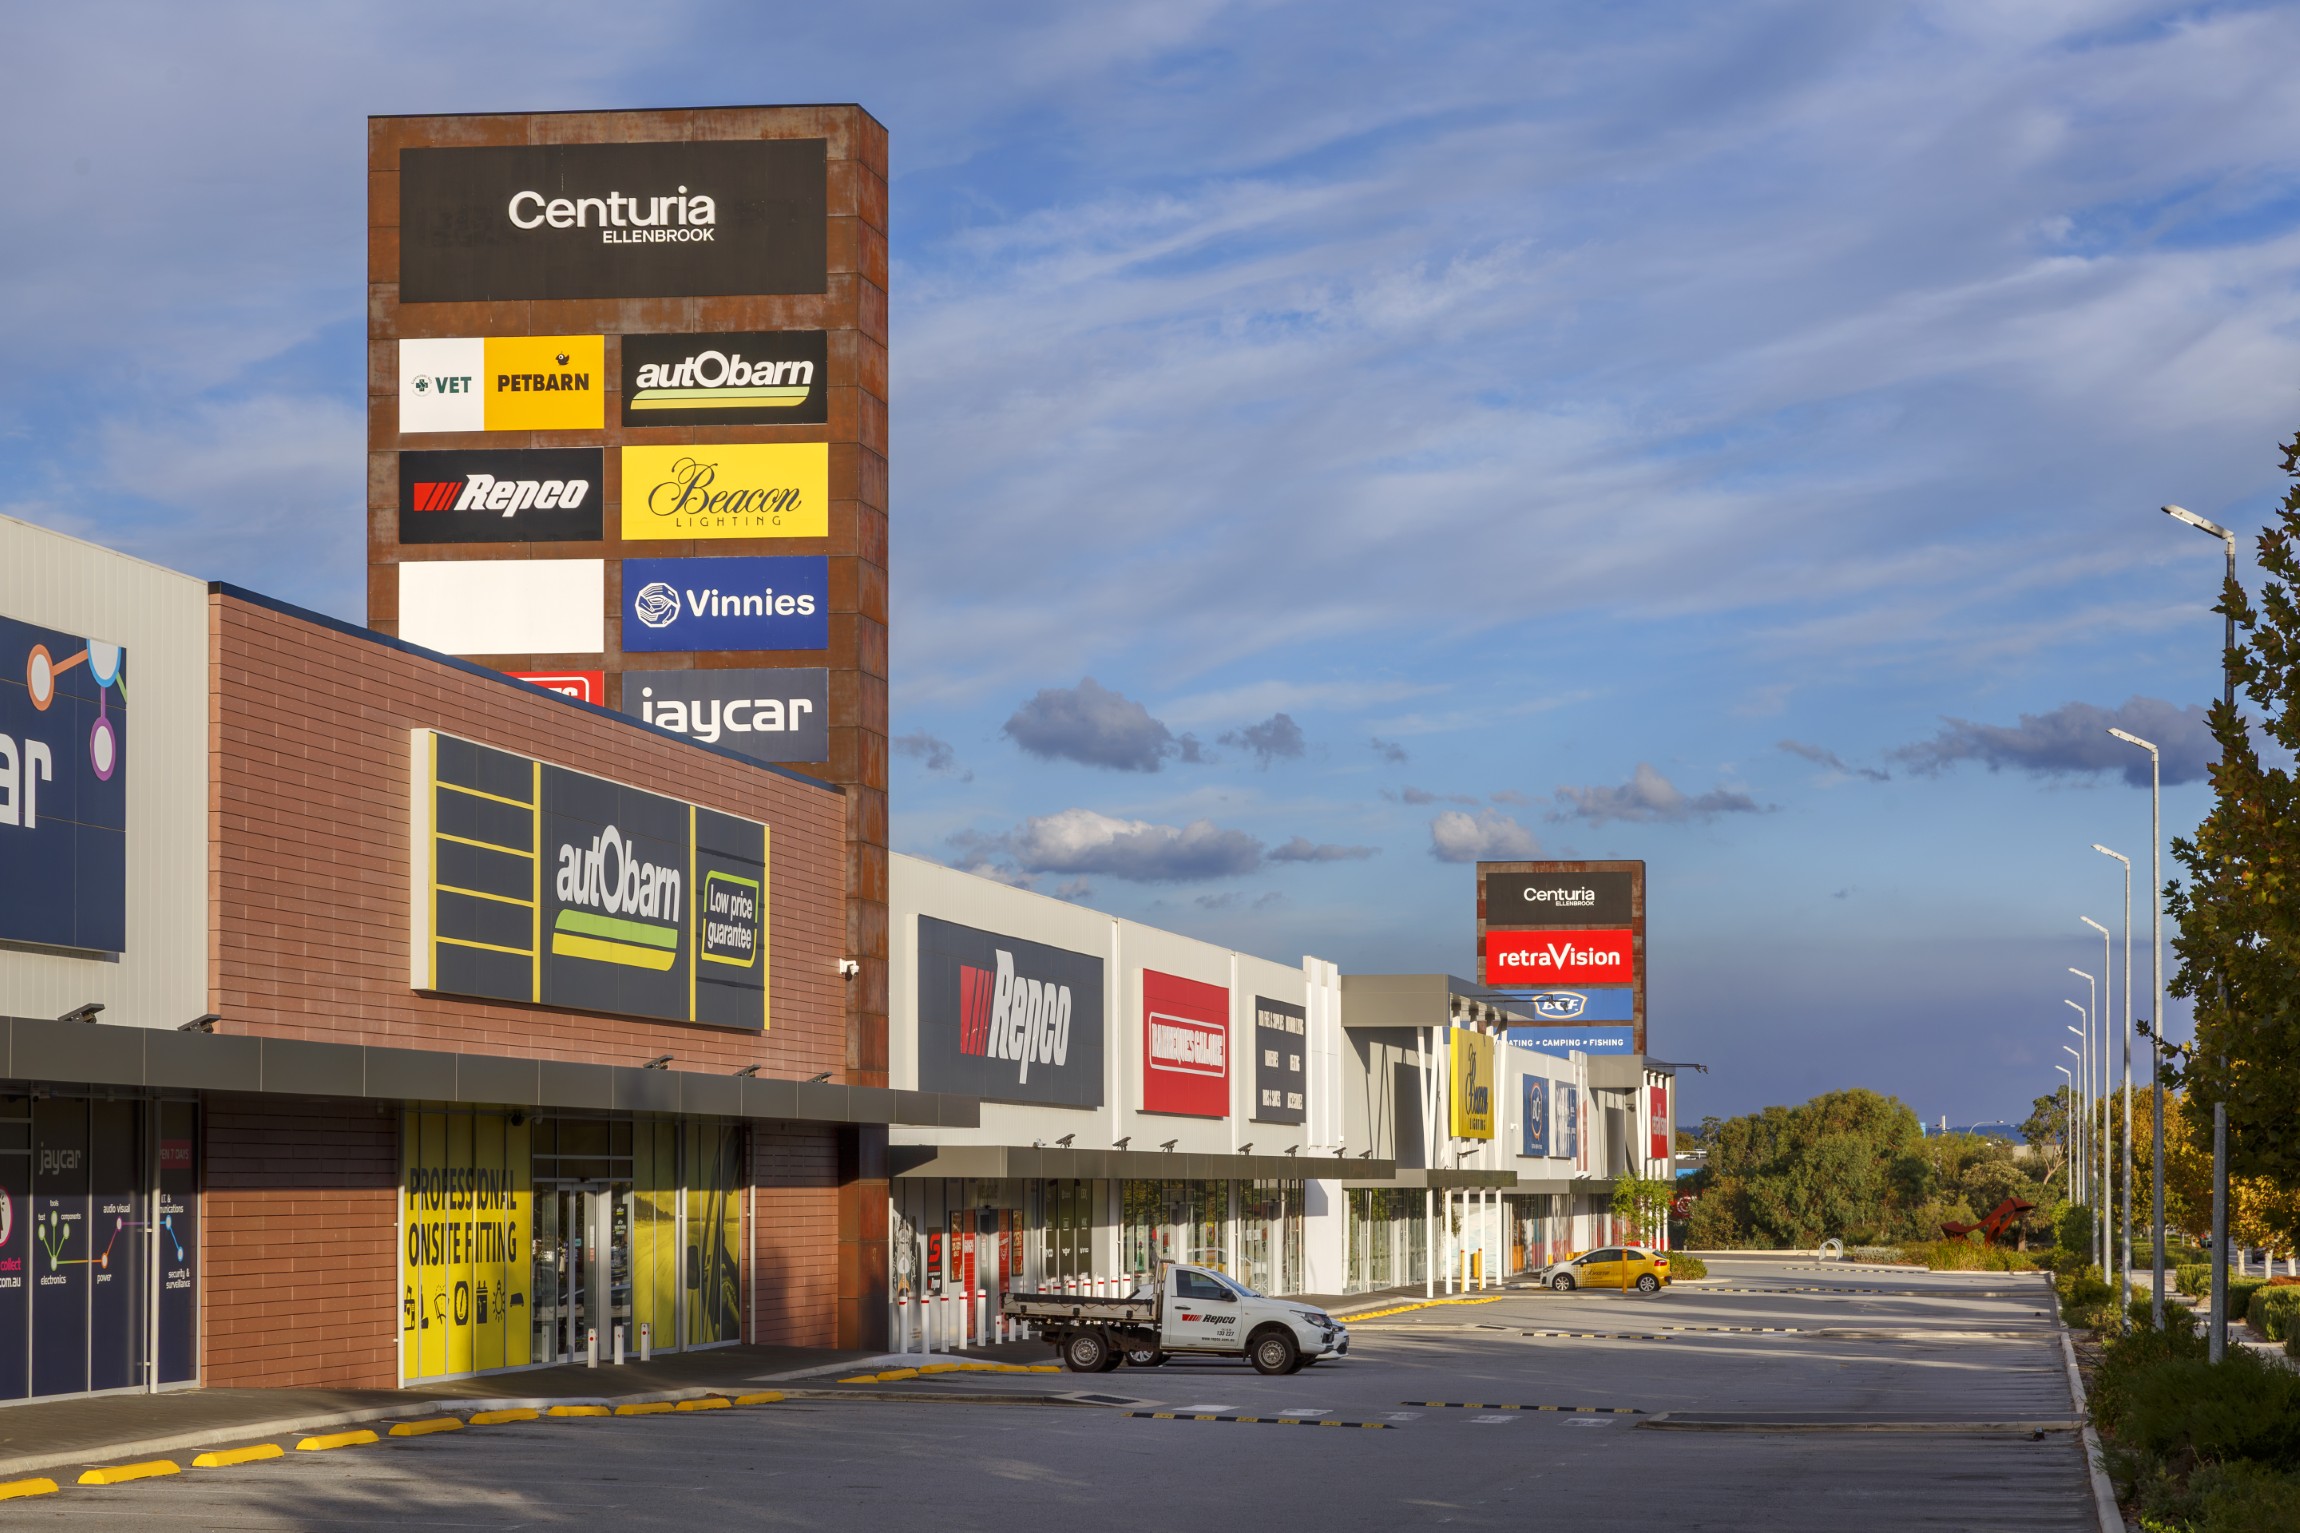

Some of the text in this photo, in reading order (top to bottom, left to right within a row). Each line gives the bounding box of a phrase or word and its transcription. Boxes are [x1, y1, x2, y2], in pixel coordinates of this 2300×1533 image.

[508, 186, 716, 230] Centuria
[603, 228, 715, 244] ELLENBROOK
[497, 373, 589, 393] PETBARN
[636, 350, 814, 389] autObarn
[435, 376, 472, 394] VET
[454, 474, 589, 518] Repco
[648, 457, 802, 515] Beacon
[676, 515, 781, 527] LIGHTING
[686, 587, 816, 617] Vinnies
[641, 687, 813, 744] jaycar
[556, 824, 681, 923] autObarn
[710, 884, 753, 921] Low price
[1523, 886, 1595, 901] Centuria
[707, 919, 752, 950] guarantee
[1499, 943, 1621, 970] retraVision
[987, 948, 1072, 1085] Repco
[1542, 997, 1579, 1011] BCF
[1508, 1038, 1624, 1047] ATING CAMPING FISHING
[38, 1141, 81, 1175] jaycar
[409, 1166, 517, 1211] PROFESSIONAL
[103, 1203, 131, 1214] audio visual
[408, 1221, 461, 1267] ONSITE
[1, 1256, 21, 1271] collect
[168, 1268, 185, 1279] security
[40, 1275, 67, 1285] electronics
[96, 1273, 112, 1284] power
[1202, 1314, 1236, 1325] Repco
